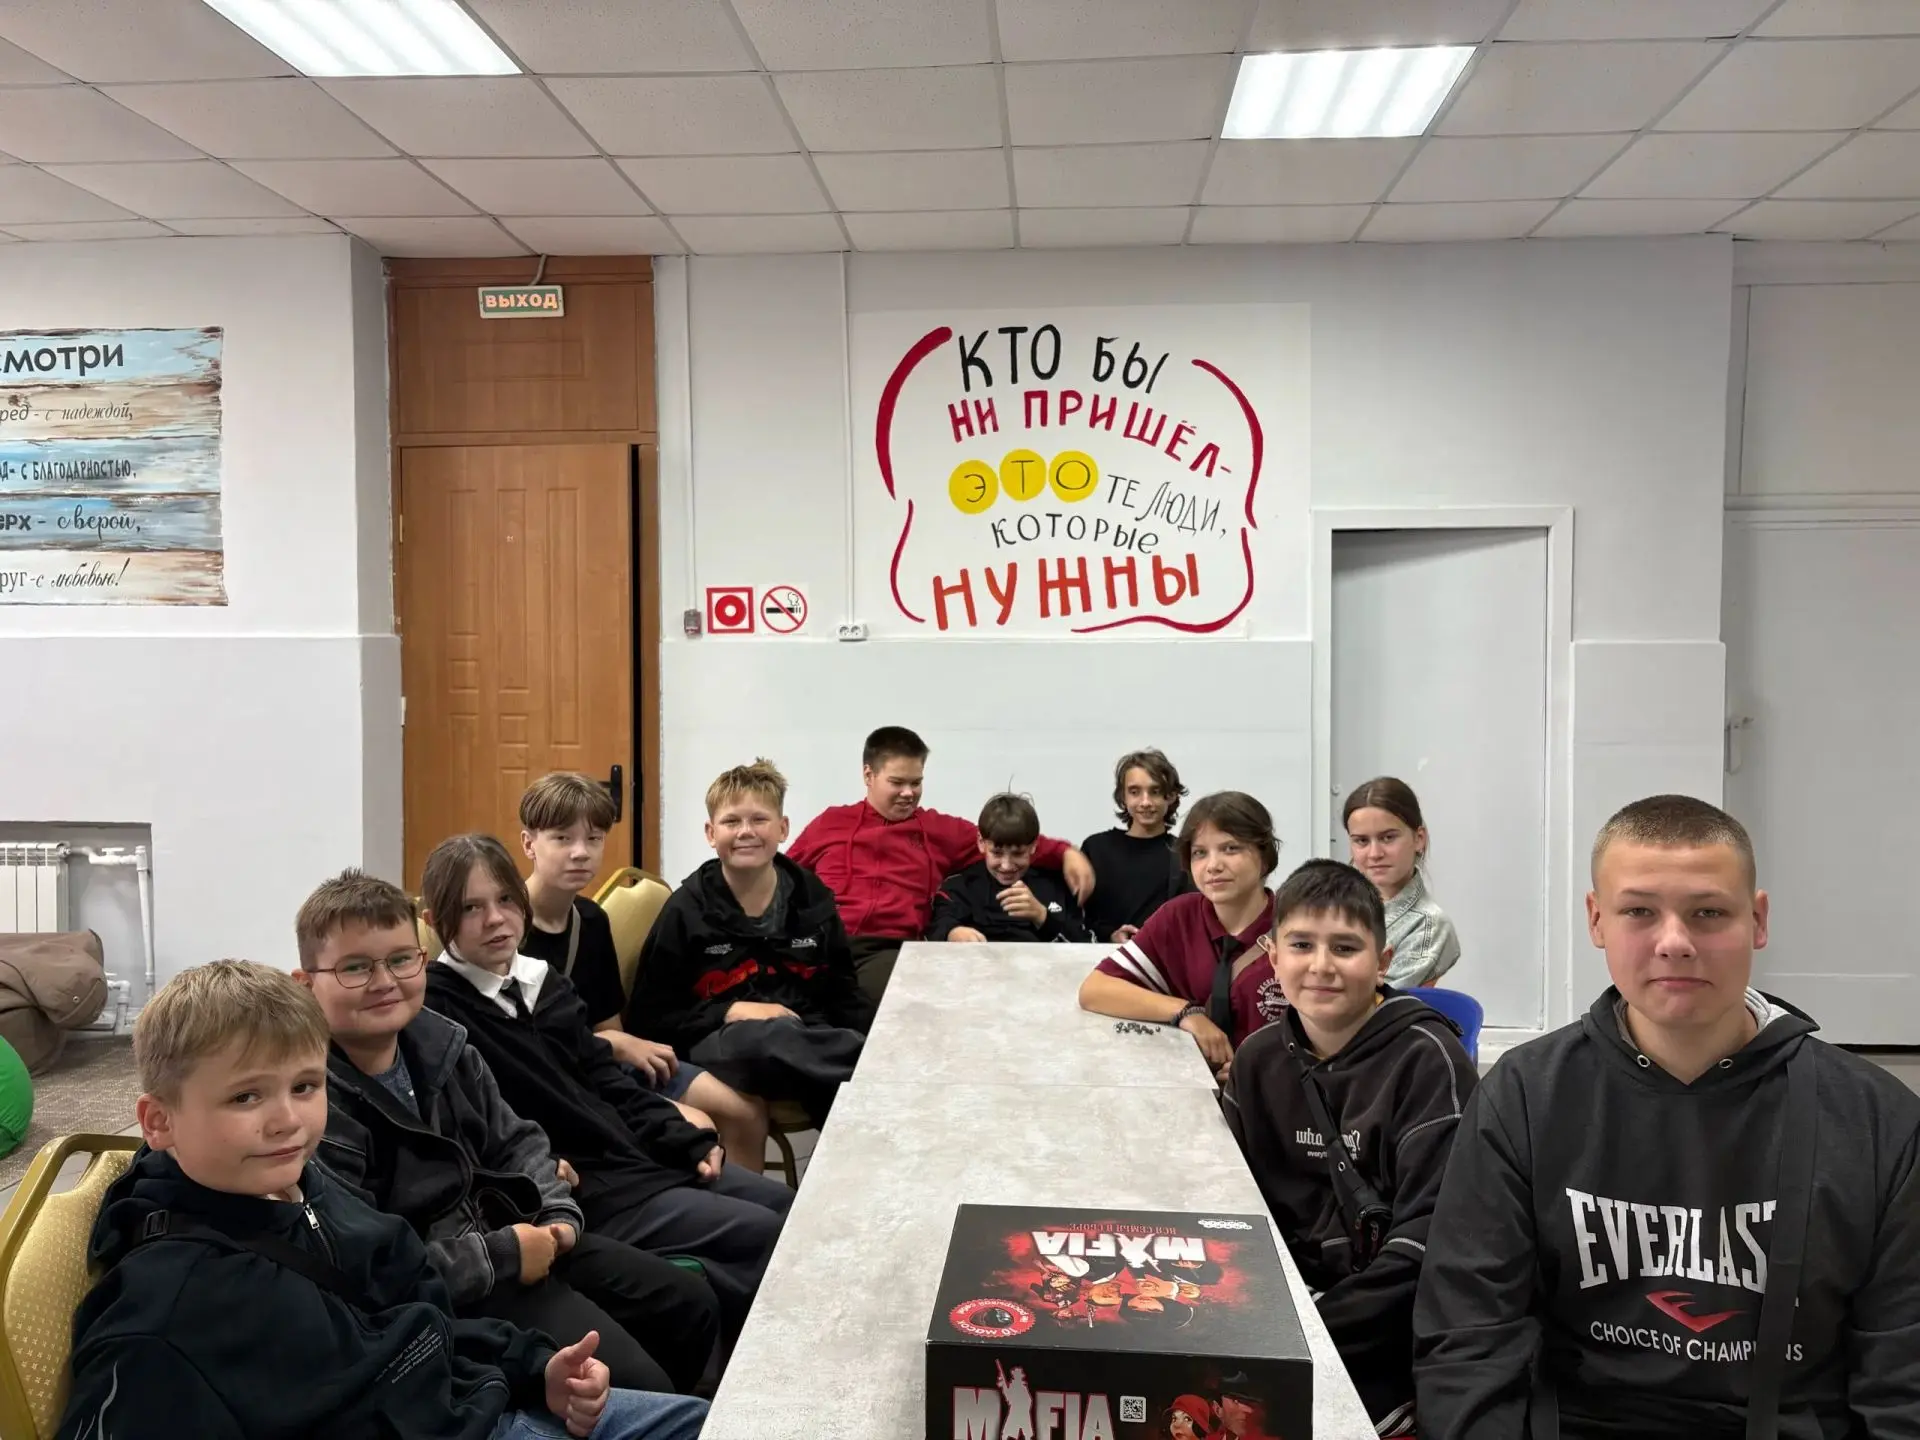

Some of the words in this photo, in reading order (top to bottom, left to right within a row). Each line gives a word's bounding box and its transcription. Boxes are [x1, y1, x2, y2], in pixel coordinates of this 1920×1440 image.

[485, 293, 557, 309] ВЫХОД
[0, 343, 124, 376] мотри
[959, 324, 1061, 391] КТО
[1093, 336, 1169, 393] БЫ
[62, 401, 133, 421] надеждой,
[948, 397, 999, 443] НИ
[33, 459, 137, 481] БЛАГОДАРНОСТЬЮ,
[963, 460, 1091, 503] ЭТО
[1107, 475, 1140, 508] ТЕ
[1135, 481, 1226, 539] ЛЮДИ,
[74, 504, 140, 540] верой,
[933, 554, 1199, 631] НУЖНЫ
[1032, 1231, 1206, 1267] MAFIA
[1590, 1321, 1660, 1349] CHOICE
[1662, 1333, 1681, 1355] OF
[1687, 1339, 1803, 1361] CHAMPS
[953, 1366, 1115, 1440] MAFIA
